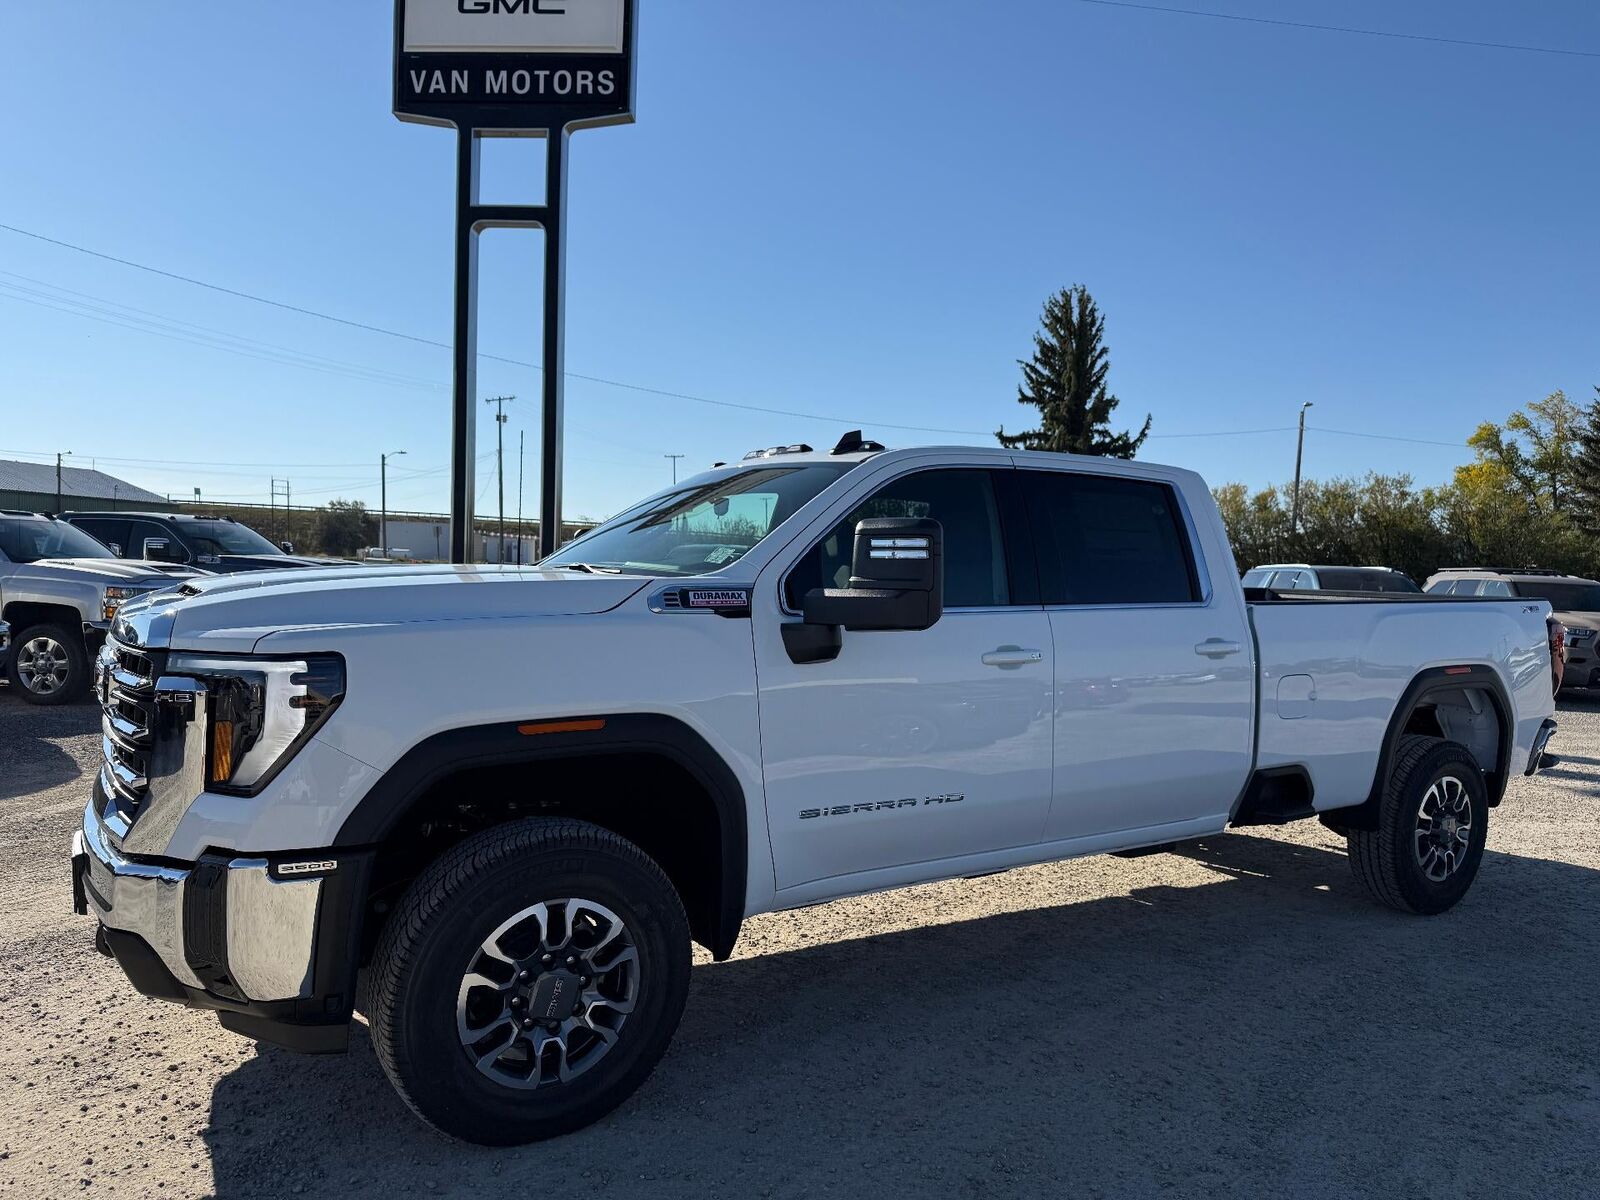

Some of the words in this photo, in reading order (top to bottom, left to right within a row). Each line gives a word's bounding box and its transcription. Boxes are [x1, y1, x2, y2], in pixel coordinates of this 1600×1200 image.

[410, 70, 469, 94] VAN
[485, 70, 616, 95] MOTORS
[693, 592, 744, 600] DURAMAX
[799, 798, 917, 819] SIERRA
[923, 792, 965, 805] HD
